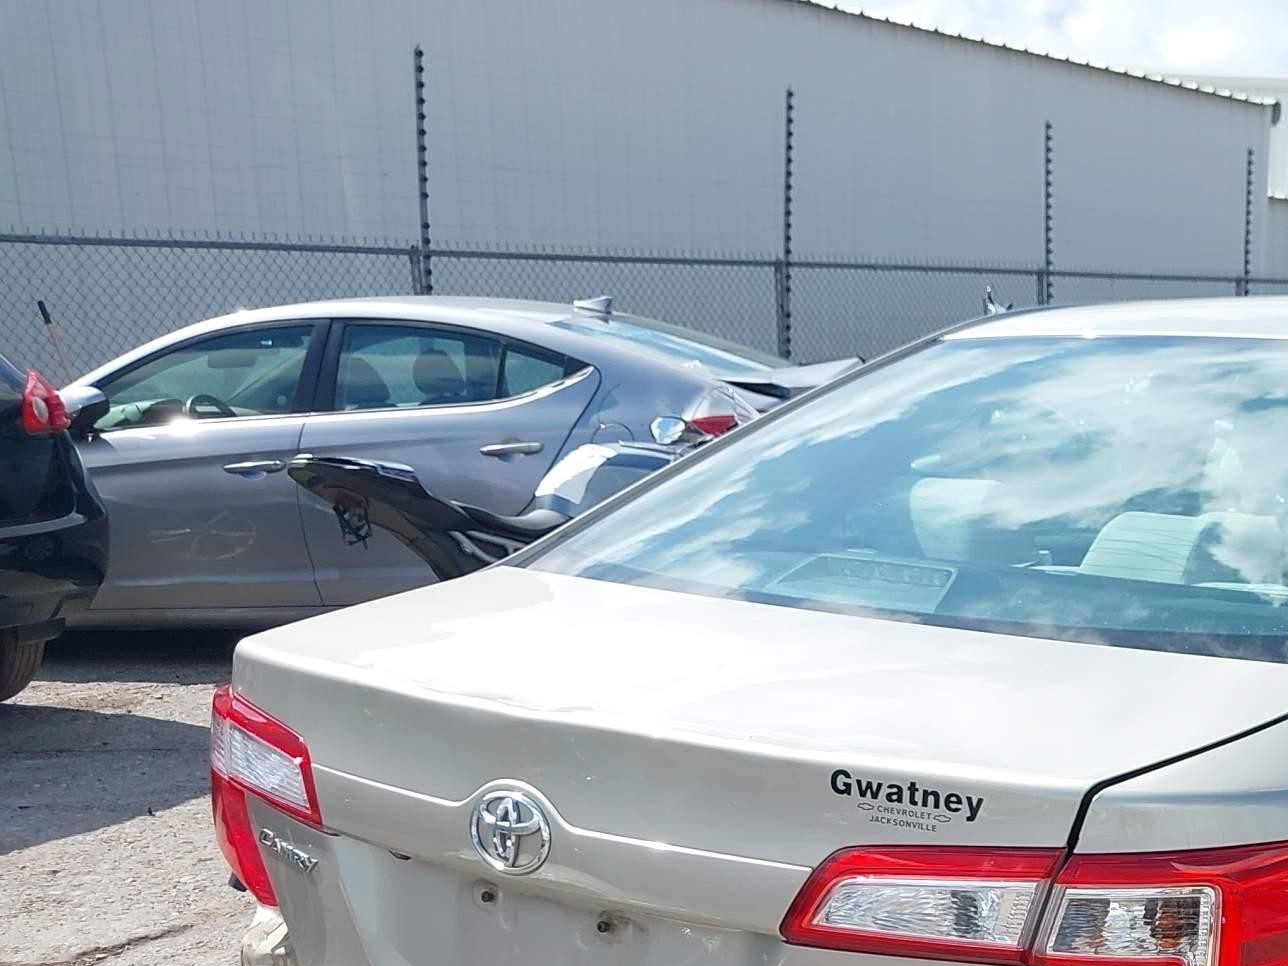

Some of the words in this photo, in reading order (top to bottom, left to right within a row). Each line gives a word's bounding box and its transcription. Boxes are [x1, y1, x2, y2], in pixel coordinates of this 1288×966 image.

[830, 769, 985, 822] Gwatney
[876, 805, 932, 820] CHEVROLET
[869, 815, 937, 832] JACKSONVILLE
